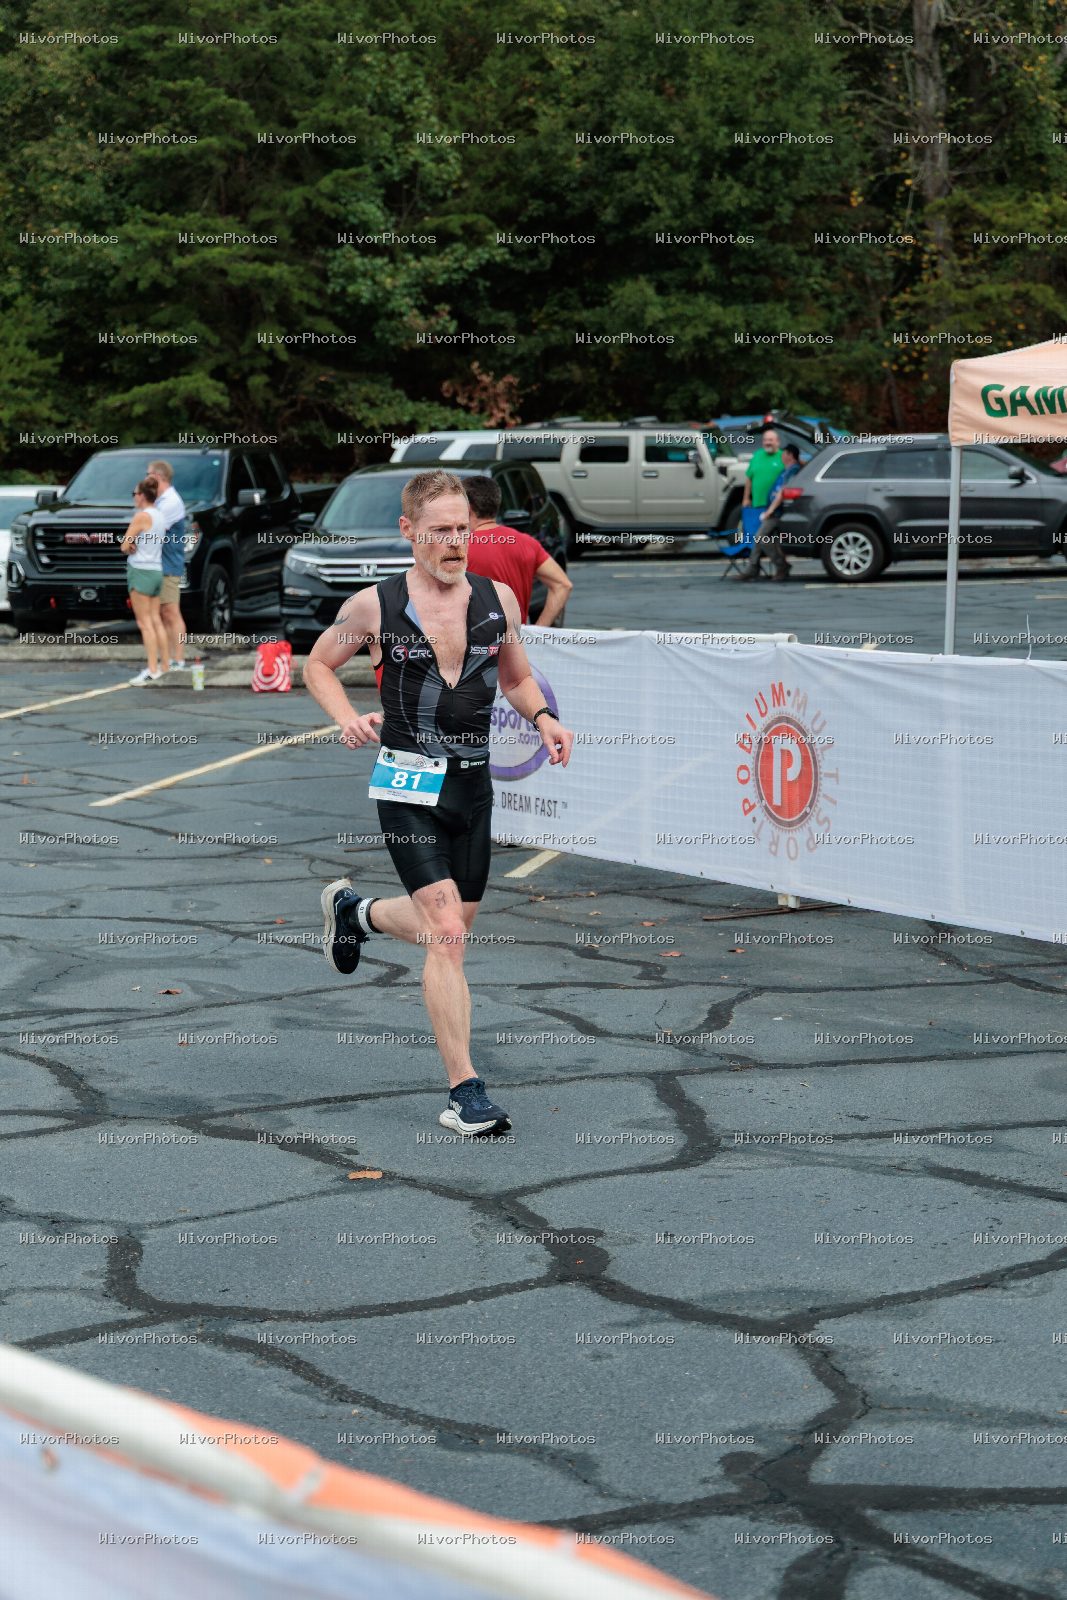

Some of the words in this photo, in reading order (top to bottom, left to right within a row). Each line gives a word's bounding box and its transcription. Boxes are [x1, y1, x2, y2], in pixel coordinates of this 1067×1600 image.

[737, 681, 786, 817] PODIUM
[772, 736, 802, 807] P
[391, 771, 422, 790] 81
[501, 791, 532, 815] DREAM
